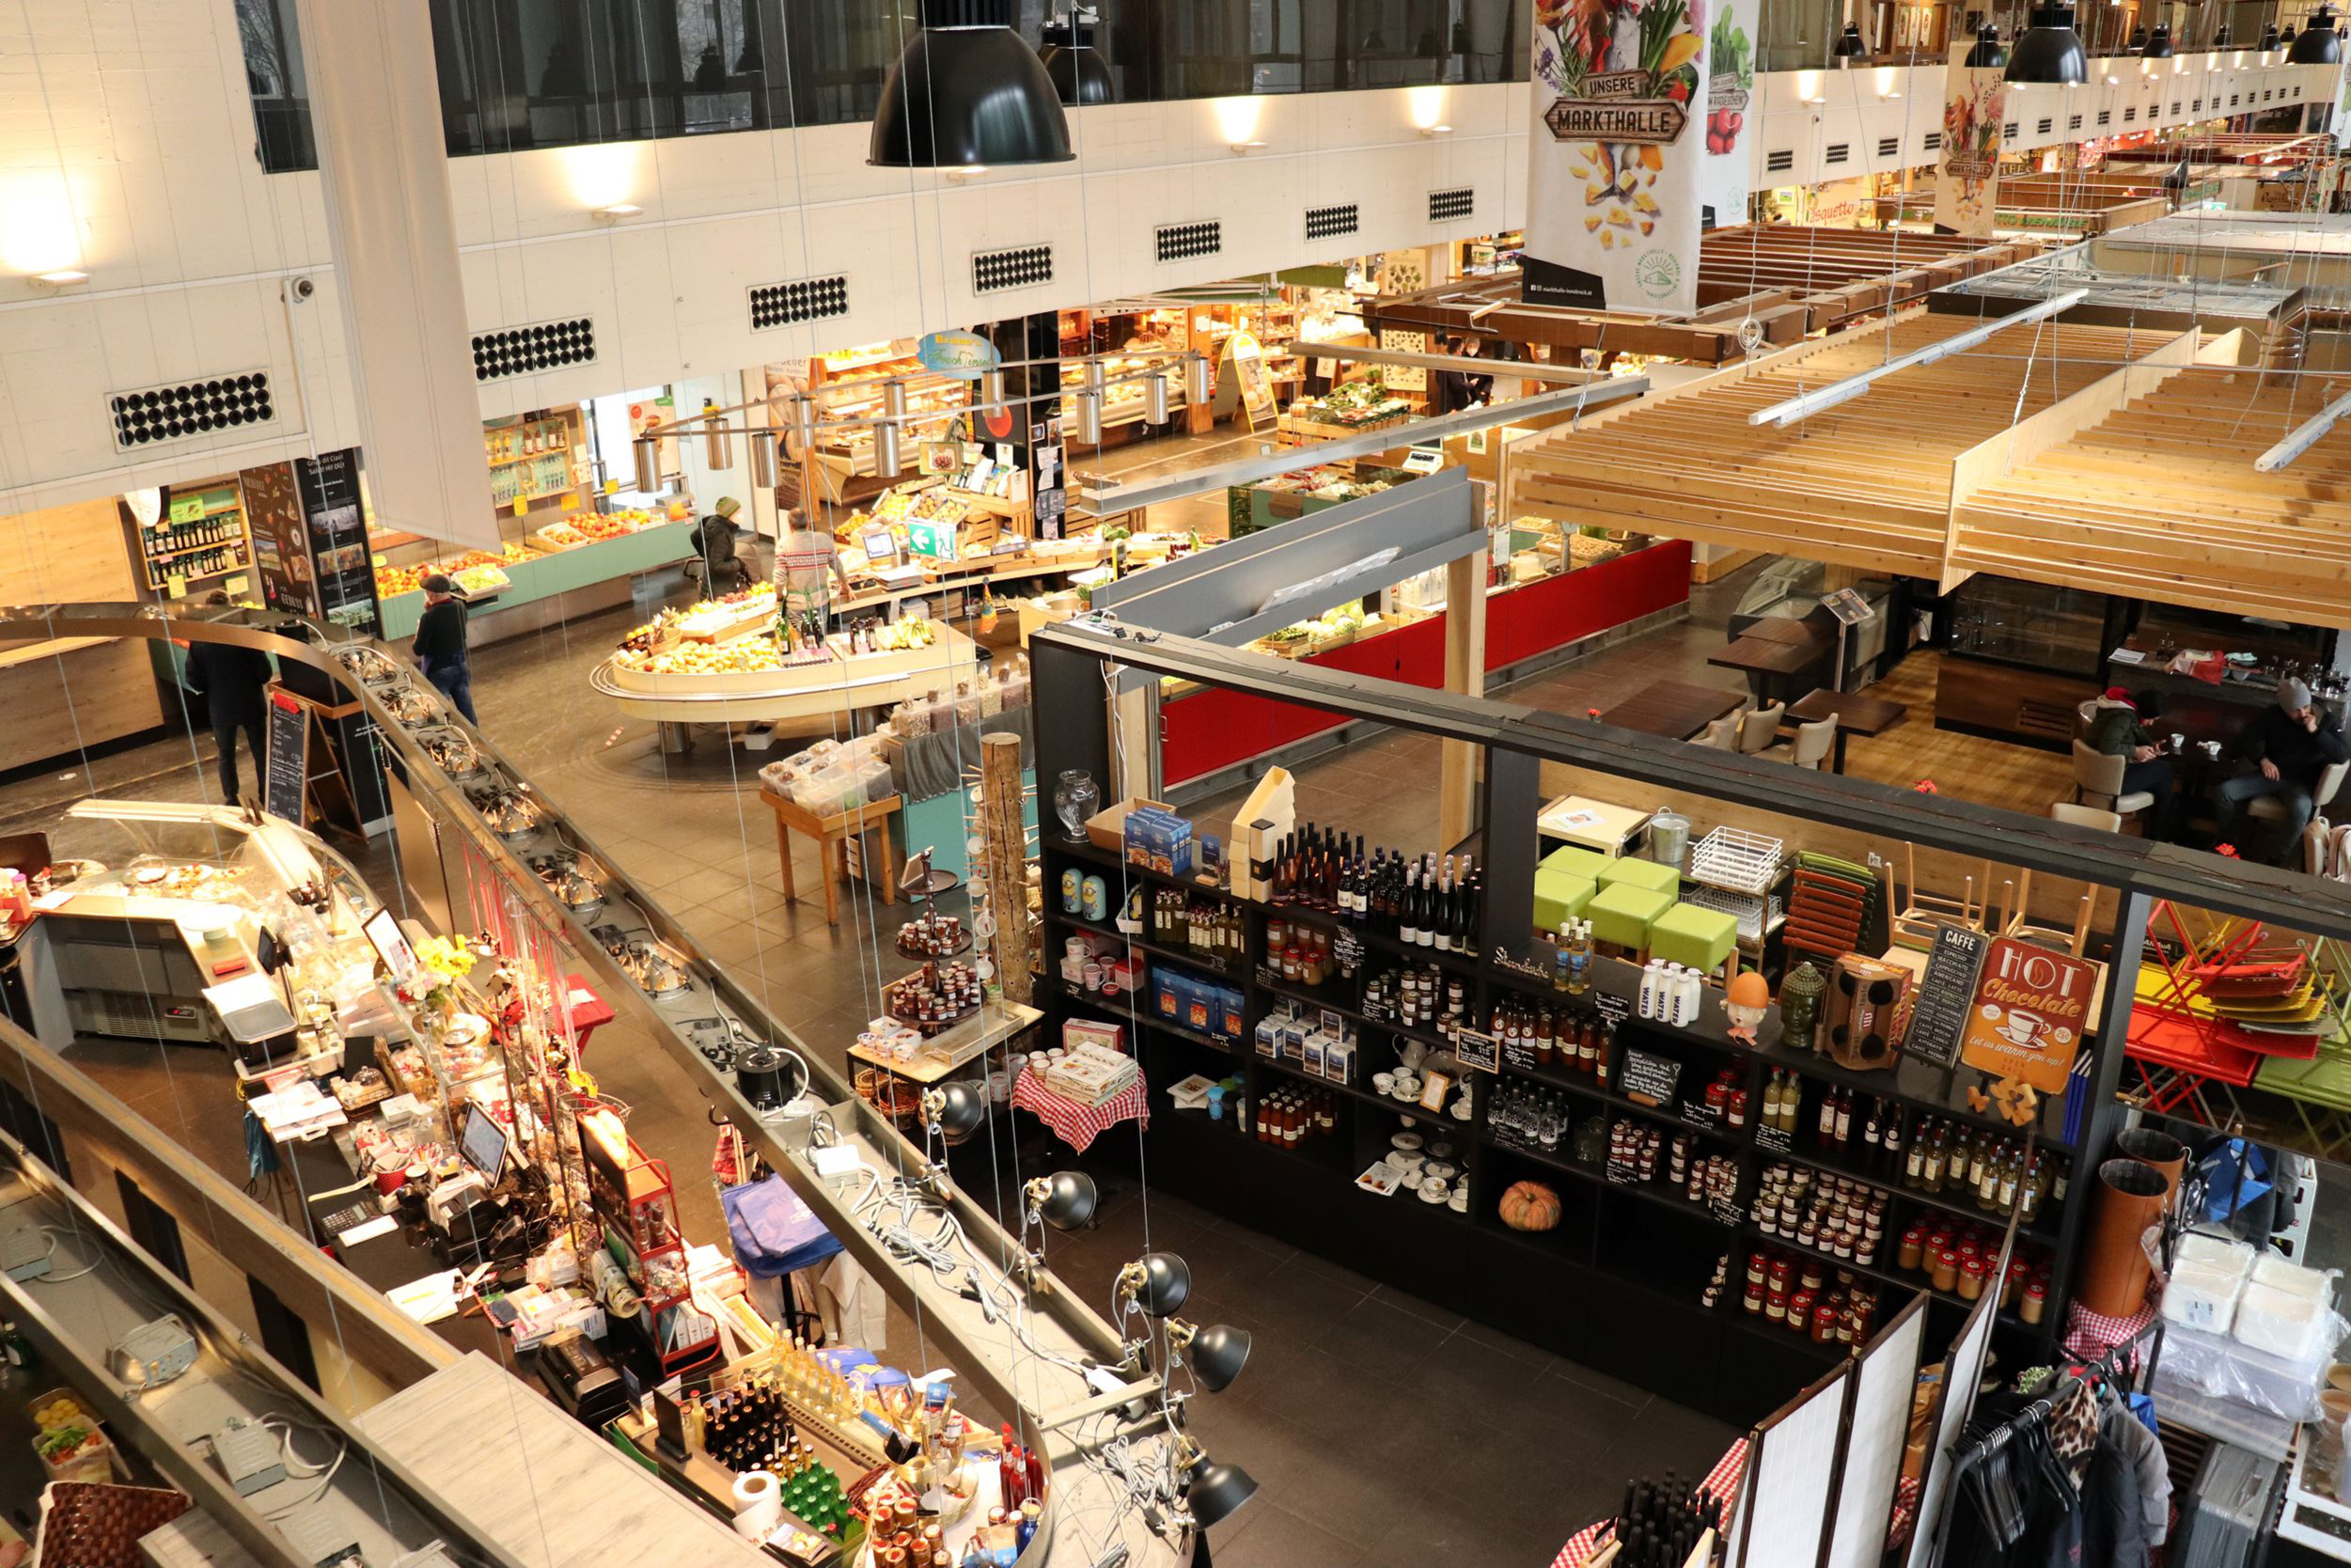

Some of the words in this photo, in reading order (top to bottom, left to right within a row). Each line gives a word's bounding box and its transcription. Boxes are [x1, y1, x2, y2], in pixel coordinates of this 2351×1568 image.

[1590, 77, 1636, 94] UNSERE
[1558, 110, 1670, 133] MARKTHALLE
[1937, 955, 1968, 971] MACCHIATO
[1944, 949, 1967, 962] ESPRESSO
[1934, 971, 1964, 986] AMERICANO
[1936, 963, 1967, 978] CAPPUCCINO
[1999, 947, 2081, 997] HOT
[1640, 987, 1650, 1015] WATER
[1657, 991, 1666, 1019] WATER
[1672, 996, 1681, 1024] WATER
[1983, 978, 2082, 1018] Chocolate
[1969, 1035, 1983, 1047] Let
[1983, 1041, 1995, 1049] us
[1995, 1043, 2028, 1058] warm
[2028, 1052, 2045, 1063] you
[2046, 1057, 2065, 1068] up!
